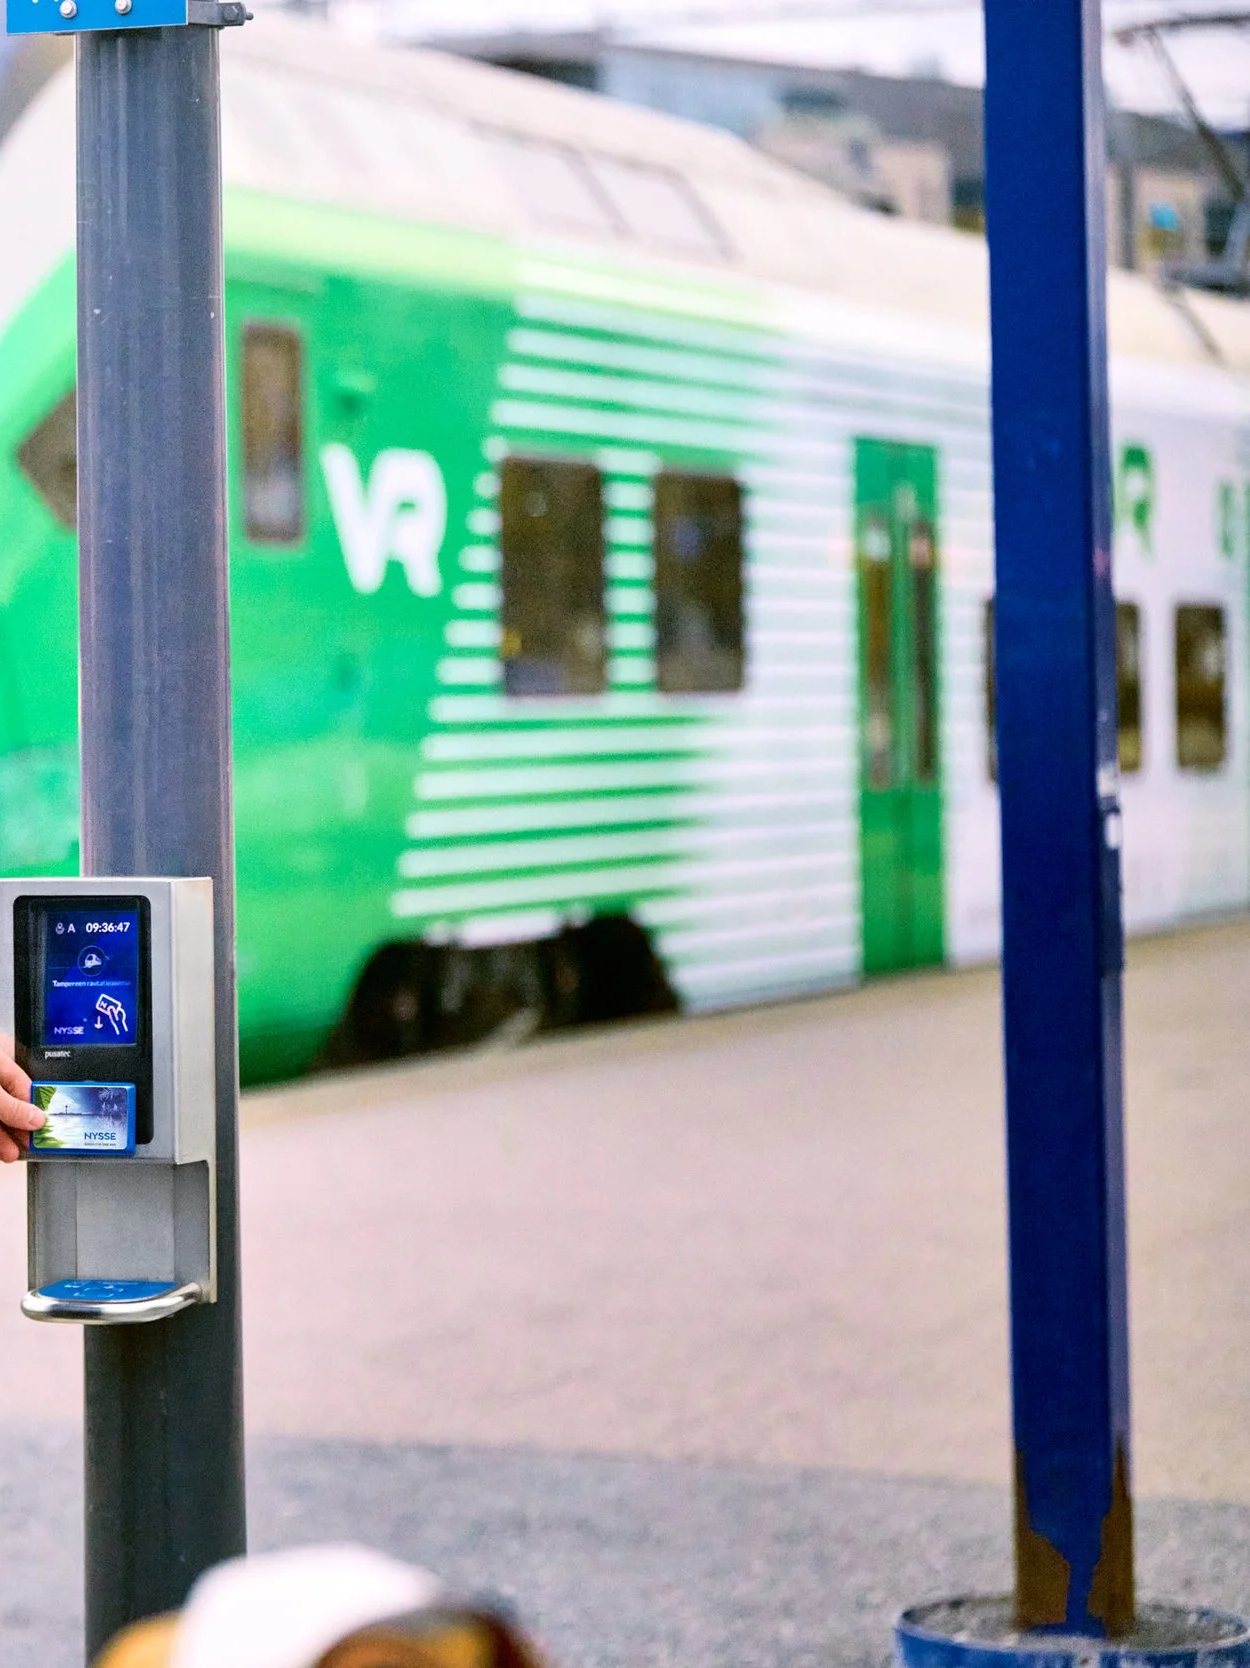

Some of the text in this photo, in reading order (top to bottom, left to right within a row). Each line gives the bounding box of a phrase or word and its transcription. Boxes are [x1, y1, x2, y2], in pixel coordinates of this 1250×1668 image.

[320, 441, 448, 597] VR
[67, 922, 130, 933] A 09:36:47
[54, 1026, 85, 1035] NYSSE
[84, 1132, 117, 1141] NYSSE
